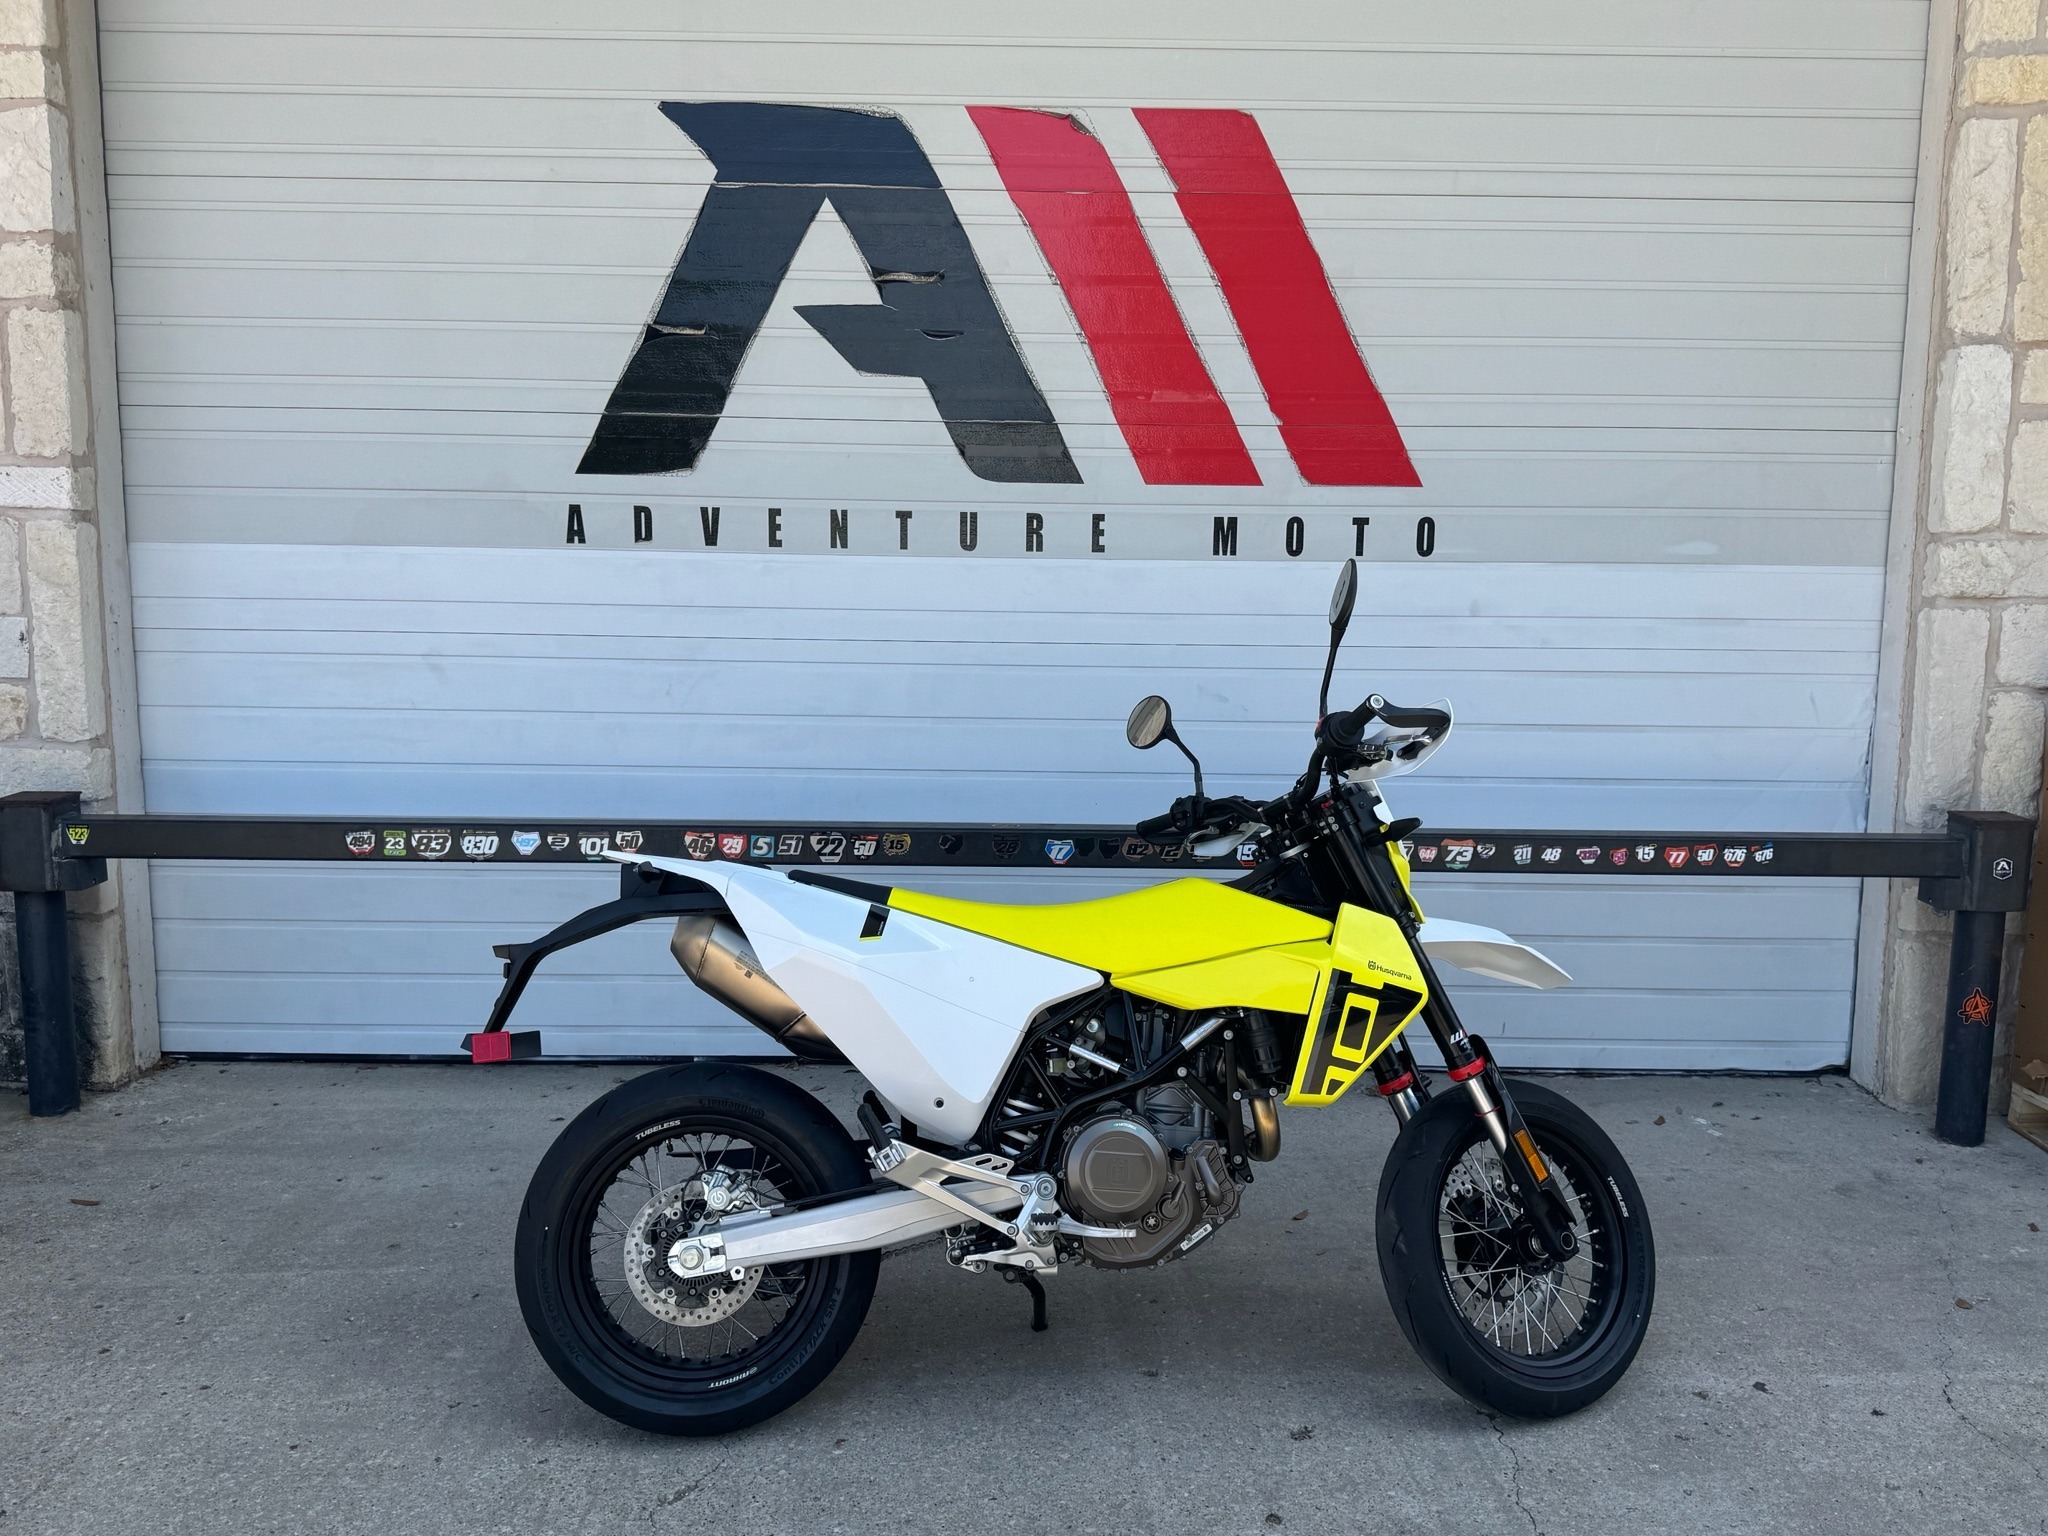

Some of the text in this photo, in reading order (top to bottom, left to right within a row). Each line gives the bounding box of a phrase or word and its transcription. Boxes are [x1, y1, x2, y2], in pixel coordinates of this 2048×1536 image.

[566, 504, 1436, 557] ADVENTURE MOTO
[69, 828, 88, 840] 523
[620, 834, 639, 849] 50
[385, 837, 405, 850] 23
[416, 835, 451, 854] 83
[463, 836, 499, 854] 830
[515, 837, 537, 848] 497
[578, 837, 609, 855] 101
[688, 838, 713, 853] 46
[723, 837, 743, 853] 29
[816, 837, 843, 857] 22
[854, 840, 877, 856] 50
[888, 839, 905, 850] 15
[1126, 844, 1149, 856] 82
[1050, 845, 1071, 859] 17
[1444, 846, 1474, 862] 73
[1514, 847, 1532, 861] 211
[1541, 848, 1562, 861] 48
[1669, 851, 1686, 864] 77
[1697, 849, 1714, 861] 50
[1376, 965, 1412, 981] Husqvarna
[634, 1119, 681, 1140] TUBELESS
[1607, 1175, 1629, 1218] TUBELESS
